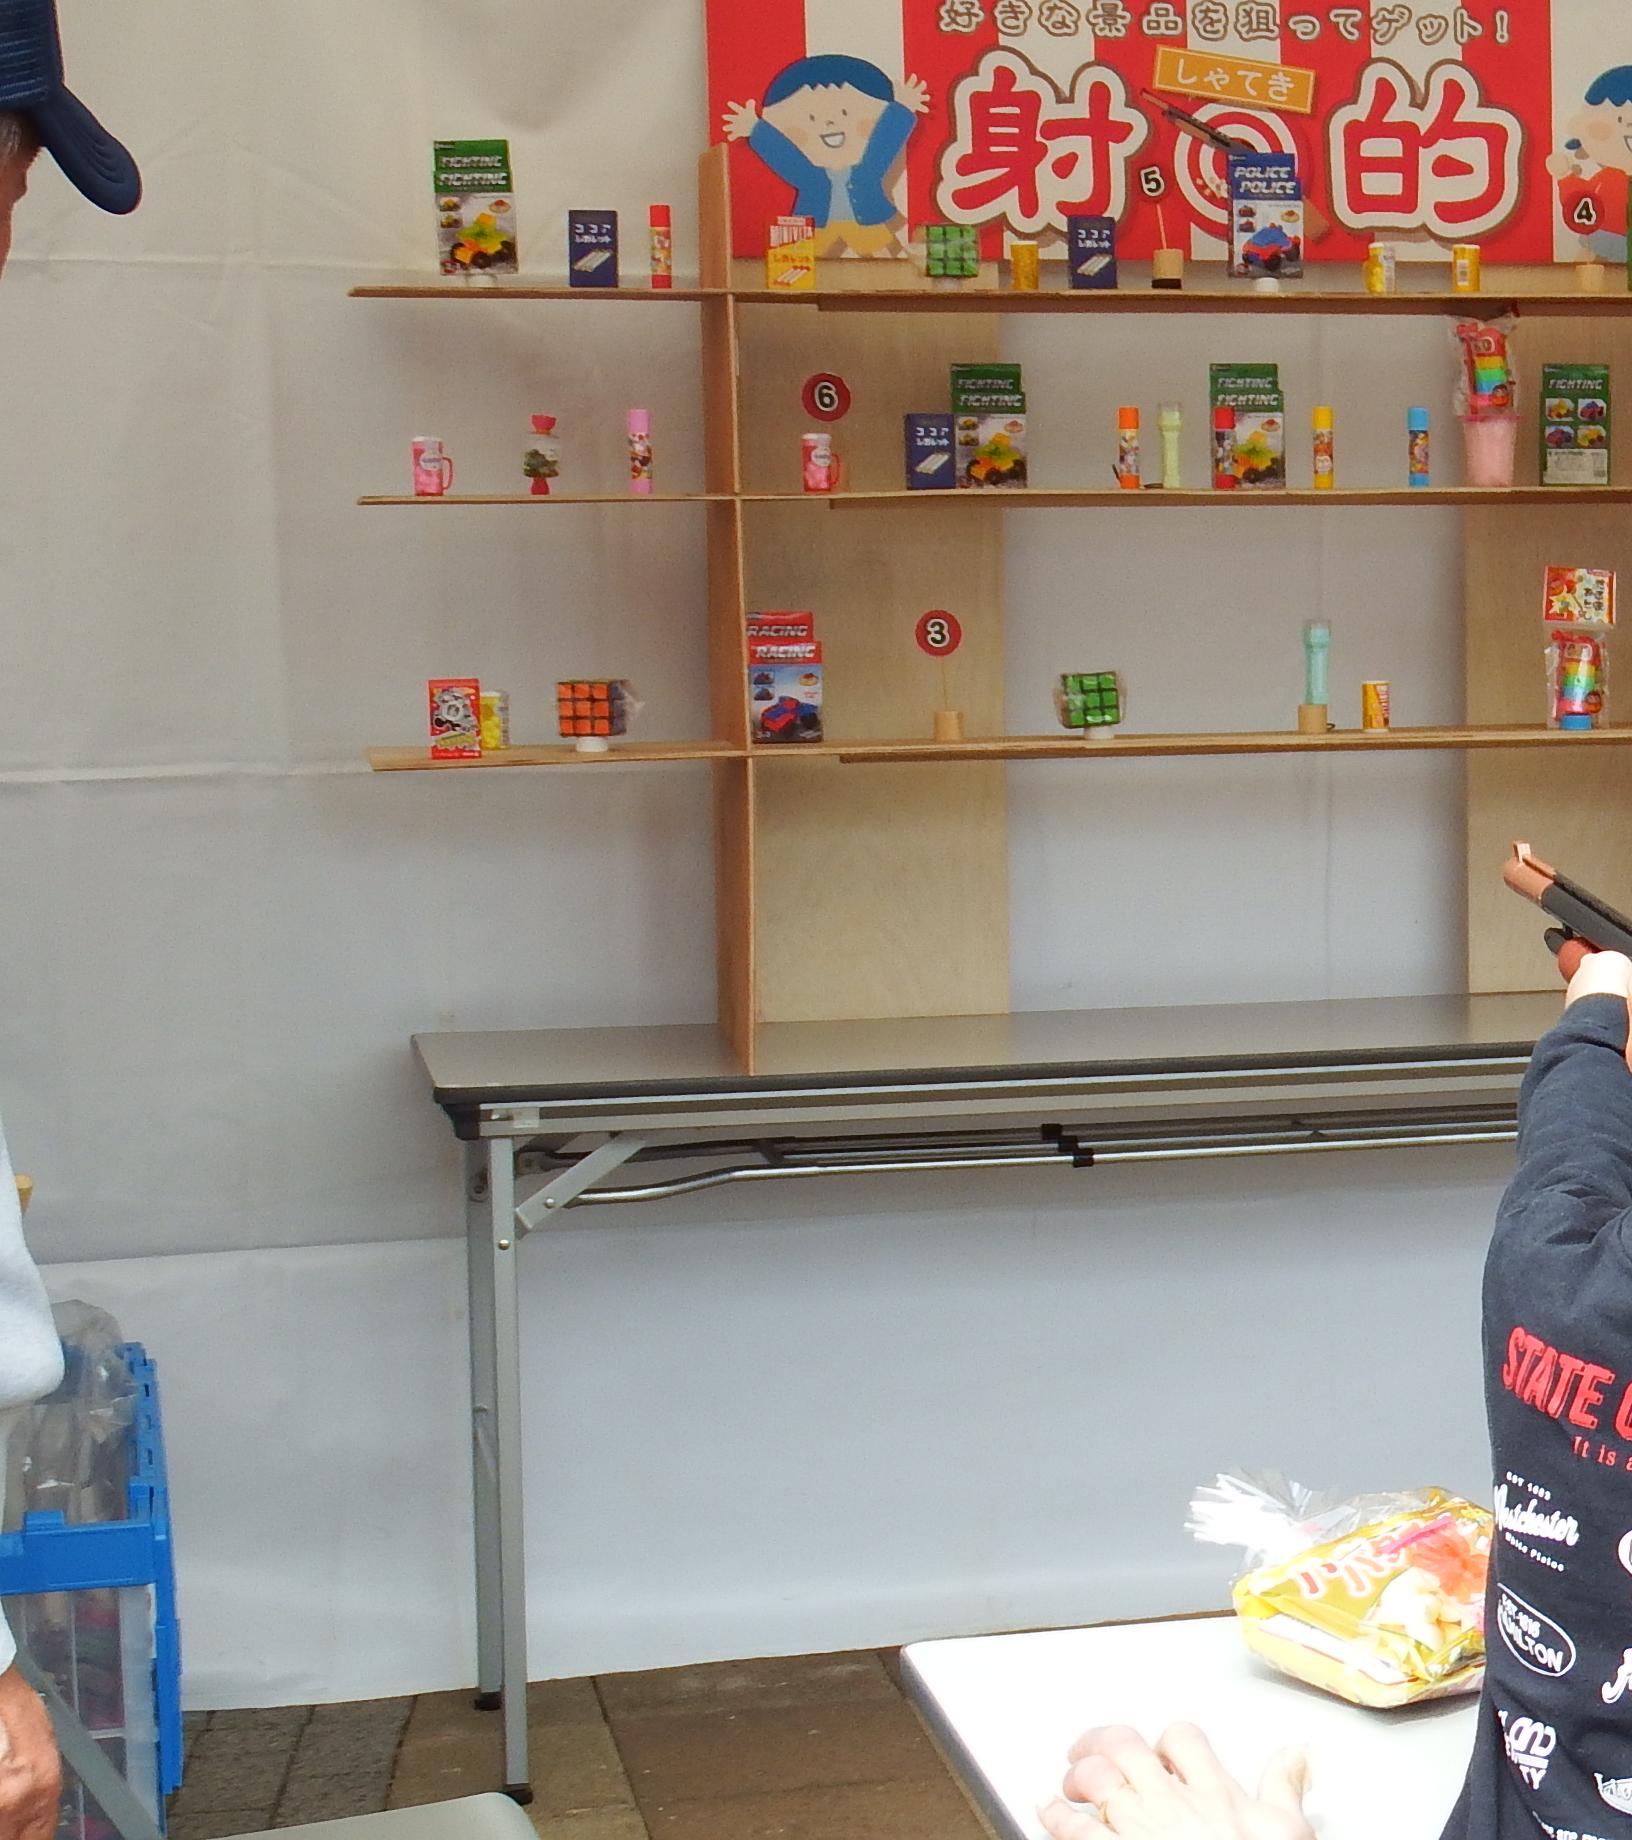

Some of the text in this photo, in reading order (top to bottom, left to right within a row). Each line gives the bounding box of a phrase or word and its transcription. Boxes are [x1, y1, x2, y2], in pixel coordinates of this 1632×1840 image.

[1176, 63, 1295, 102] しゃてき
[950, 64, 1510, 224] 射 的
[1142, 167, 1164, 196] 5
[1234, 166, 1292, 179] POLICE
[1240, 181, 1297, 195] POLICE
[1575, 198, 1596, 224] 4
[815, 382, 837, 411] 6
[1548, 379, 1604, 390] FIGHTING
[928, 618, 950, 647] 3
[755, 645, 816, 658] RACING
[1502, 1326, 1616, 1430] STATE
[1573, 1436, 1589, 1458] It
[1599, 1444, 1617, 1467] is
